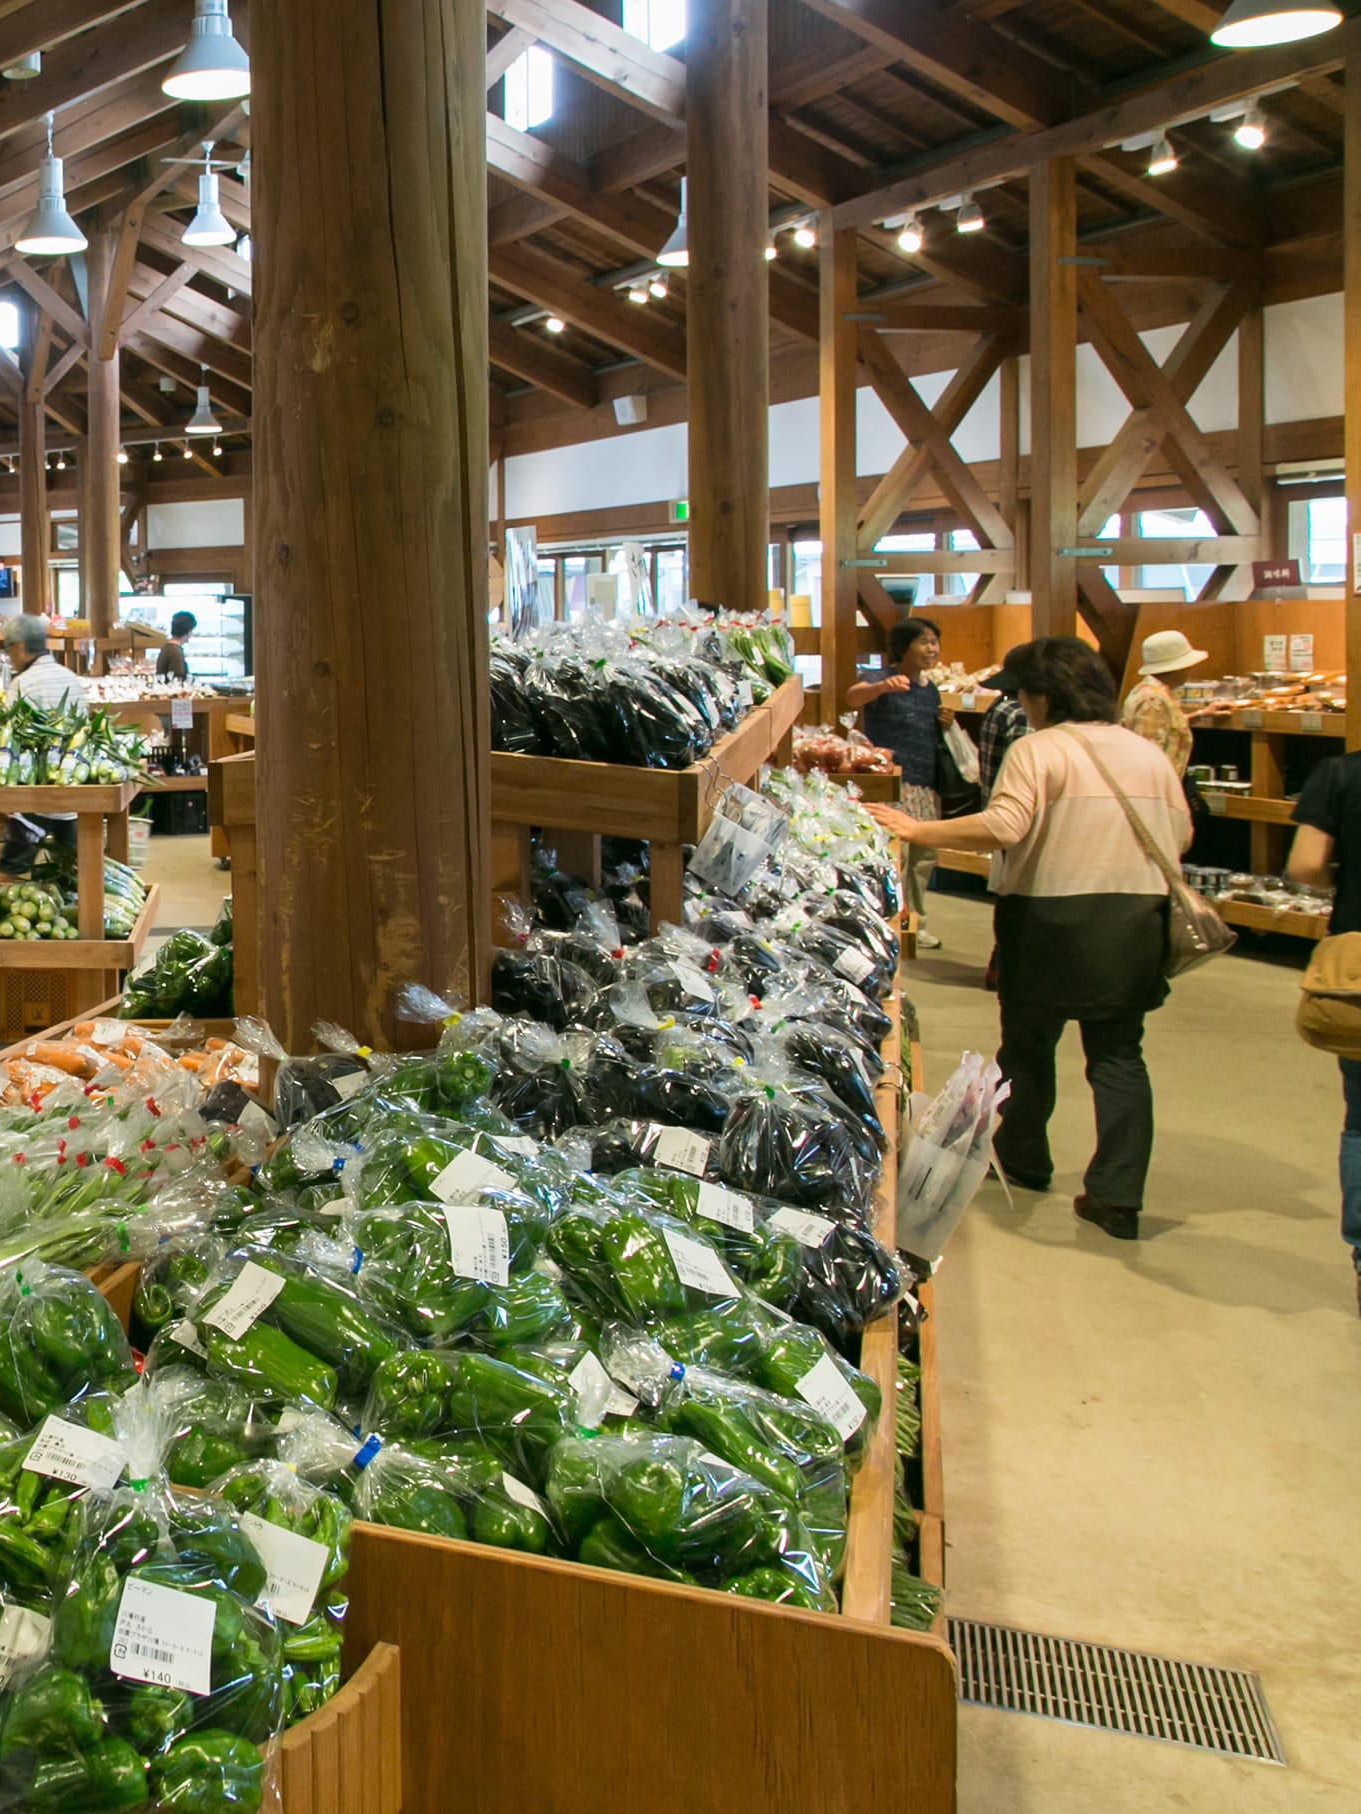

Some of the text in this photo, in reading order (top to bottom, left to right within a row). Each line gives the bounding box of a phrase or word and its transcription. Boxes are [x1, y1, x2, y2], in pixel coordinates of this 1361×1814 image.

[52, 1467, 78, 1481] ¥130
[127, 1583, 153, 1596] ピーマン
[143, 1666, 172, 1684] ¥140
